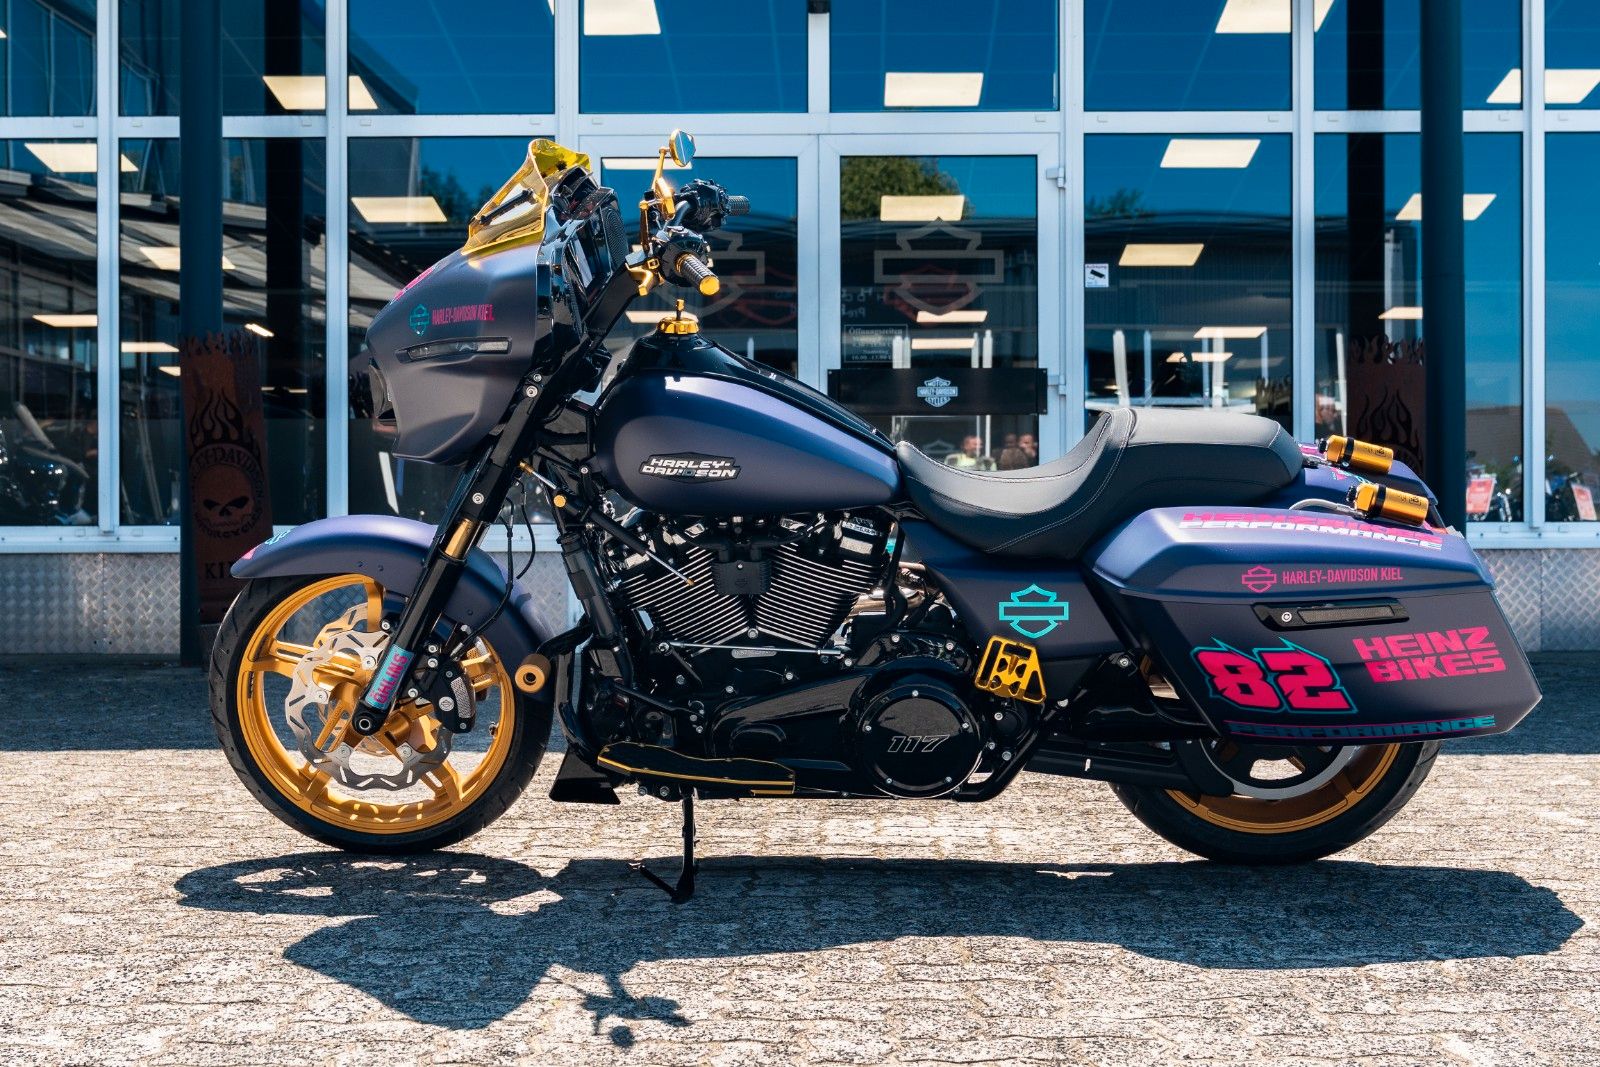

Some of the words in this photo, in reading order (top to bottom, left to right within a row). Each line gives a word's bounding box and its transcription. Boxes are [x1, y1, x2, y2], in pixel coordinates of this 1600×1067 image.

[432, 306, 477, 325] HARLEY-DAVIDSON
[478, 304, 495, 321] KIEL
[641, 465, 736, 478] DAVIDSON
[650, 458, 731, 469] HARLEY-
[1179, 521, 1442, 550] PERFORMANCE
[1282, 568, 1378, 584] HARLEY-DAVIDSON
[1380, 567, 1404, 581] KIEL
[1353, 626, 1496, 661] HEINZ
[1364, 650, 1506, 683] BIKES
[1196, 648, 1353, 710] 82
[1229, 715, 1496, 738] PERFORMANCE
[887, 734, 951, 753] 117
